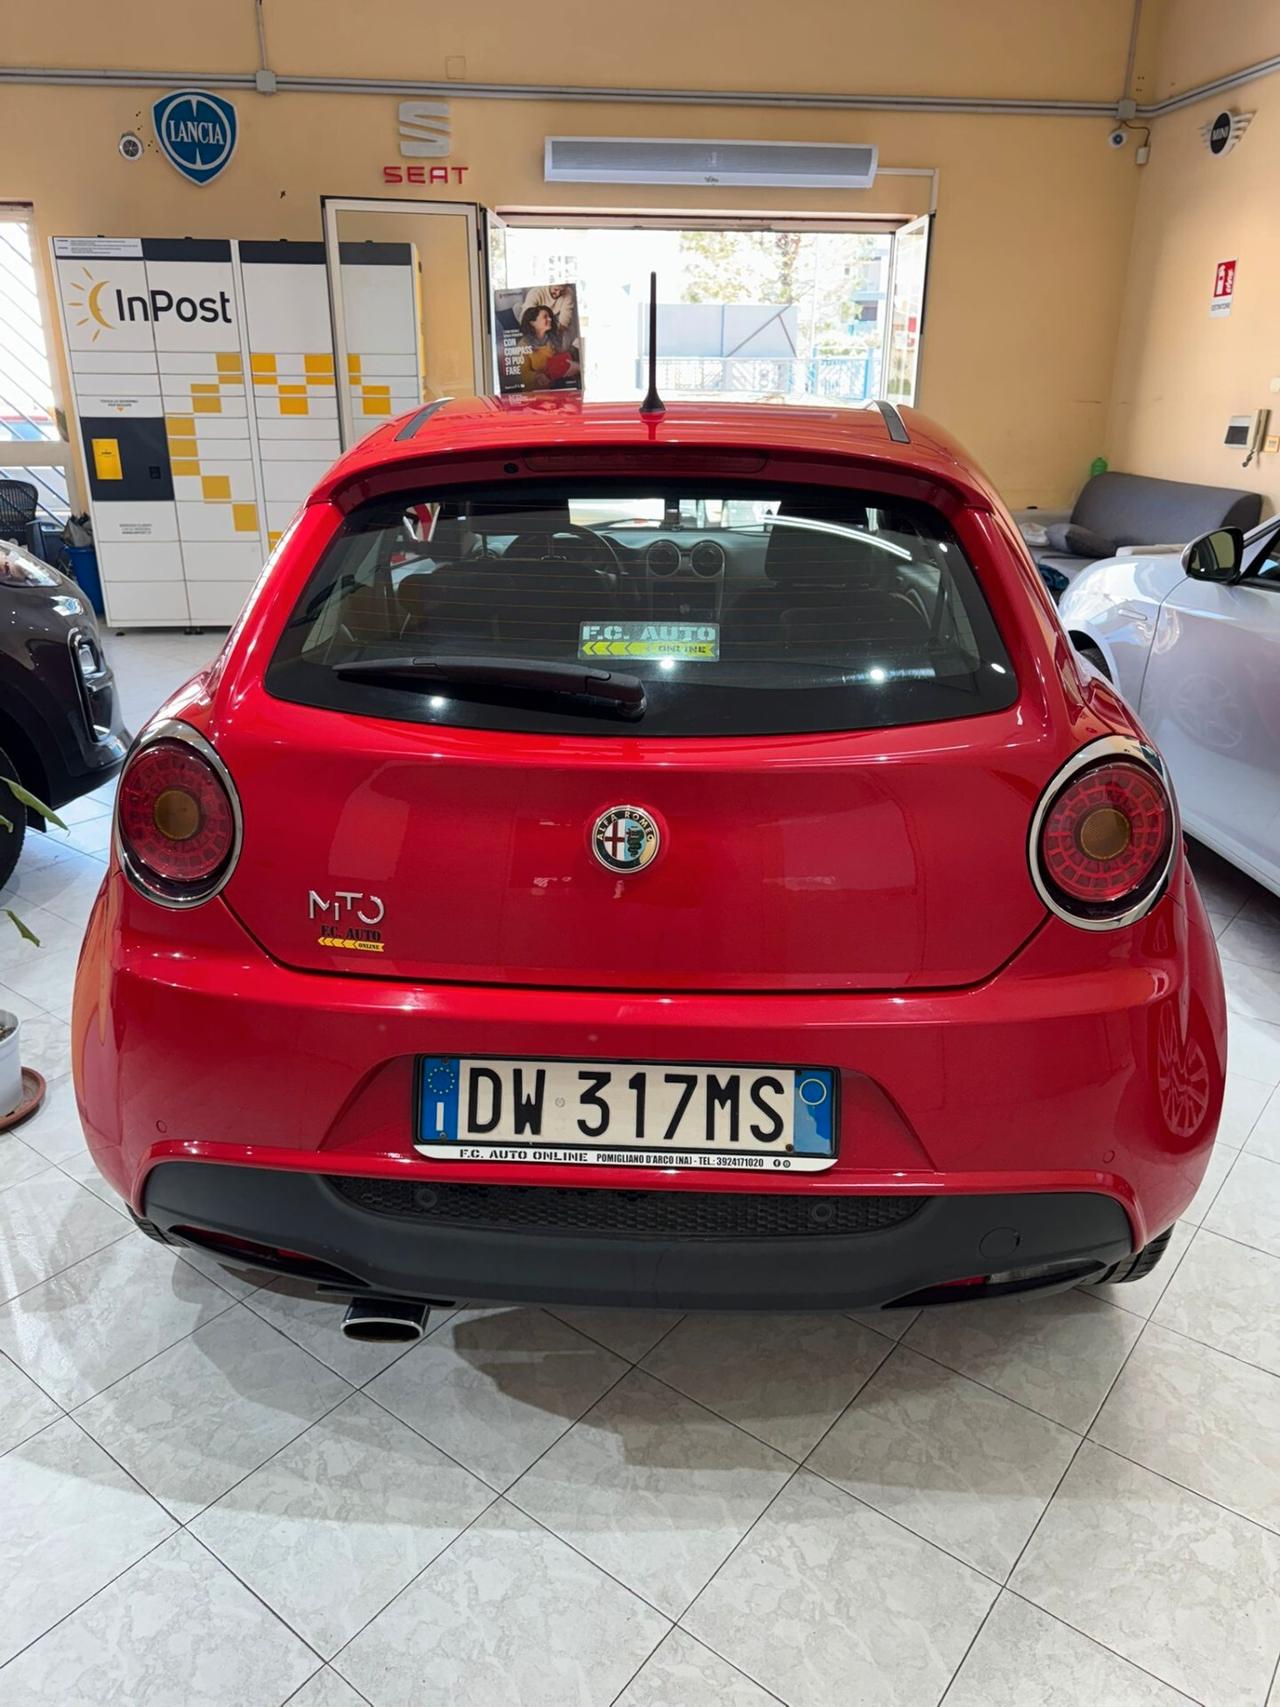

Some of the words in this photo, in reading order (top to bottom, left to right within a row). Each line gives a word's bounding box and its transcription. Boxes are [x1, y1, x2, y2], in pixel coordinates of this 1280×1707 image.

[169, 120, 224, 145] LANCIA
[1212, 126, 1229, 141] MINI
[383, 166, 469, 184] SEAT
[116, 289, 232, 323] InPost
[503, 338, 517, 347] CON
[504, 345, 533, 356] COMPASS
[506, 366, 521, 376] FARE
[582, 625, 630, 640] F.C.
[640, 626, 716, 641] AUTO
[597, 814, 617, 841] ALFA
[624, 811, 654, 842] ROMEO
[347, 928, 382, 941] AUTO
[468, 1068, 546, 1135] DW
[577, 1071, 784, 1143] 317MS
[459, 1149, 484, 1159] F.C.
[489, 1150, 527, 1160] AUTO
[533, 1151, 588, 1162] ONLINE
[596, 1153, 645, 1165] POMIGLIANO
[716, 1157, 764, 1168] 3924171020
